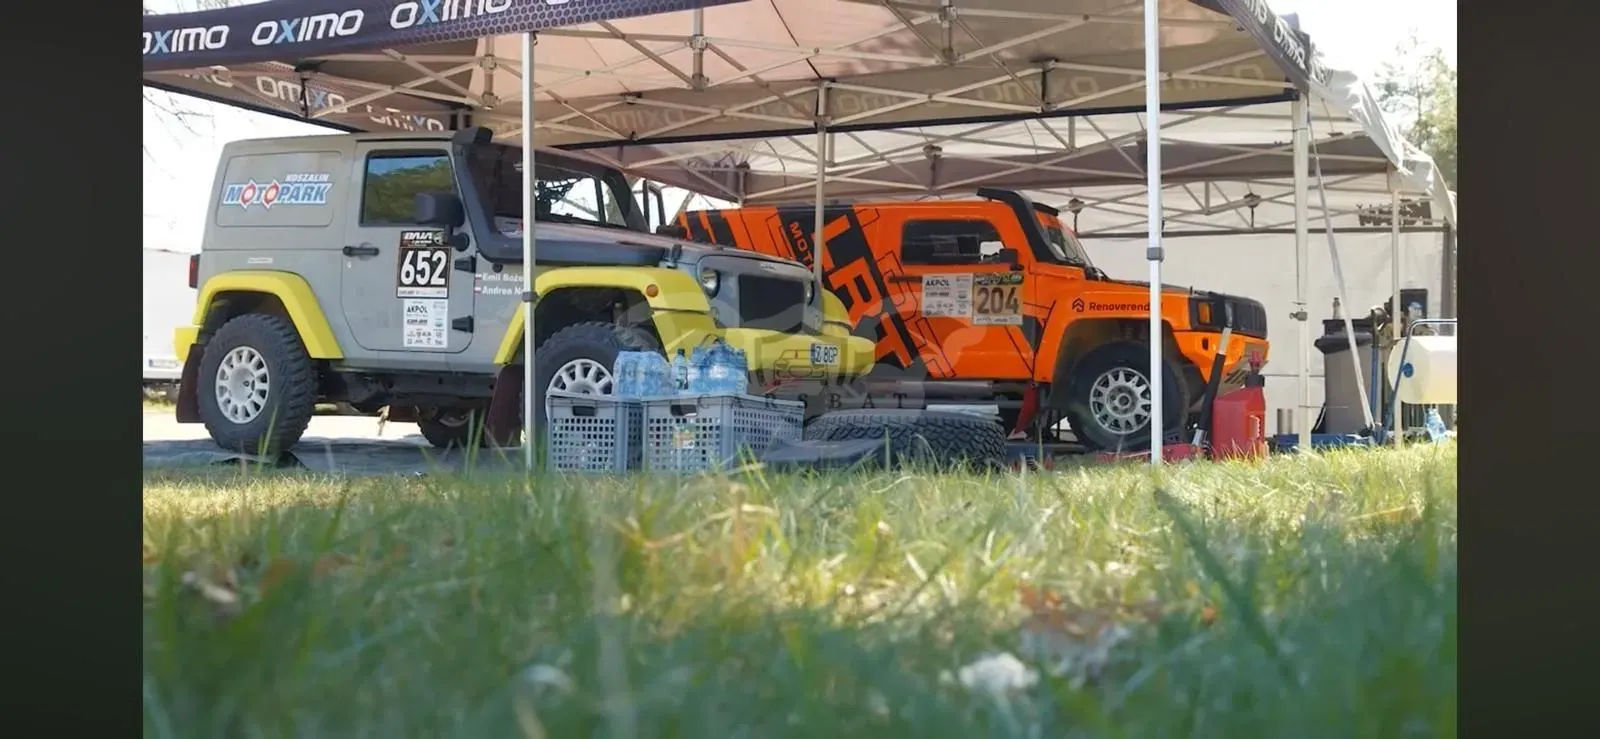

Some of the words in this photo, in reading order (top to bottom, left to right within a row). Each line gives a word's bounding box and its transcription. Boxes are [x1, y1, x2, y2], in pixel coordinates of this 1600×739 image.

[251, 9, 364, 45] OXIMO
[222, 179, 333, 209] MOTOPARK
[401, 250, 447, 286] 652
[483, 272, 501, 281] Emil
[482, 286, 513, 295] Andrea
[977, 286, 1019, 315] 204
[1088, 301, 1164, 311] Renoverend
